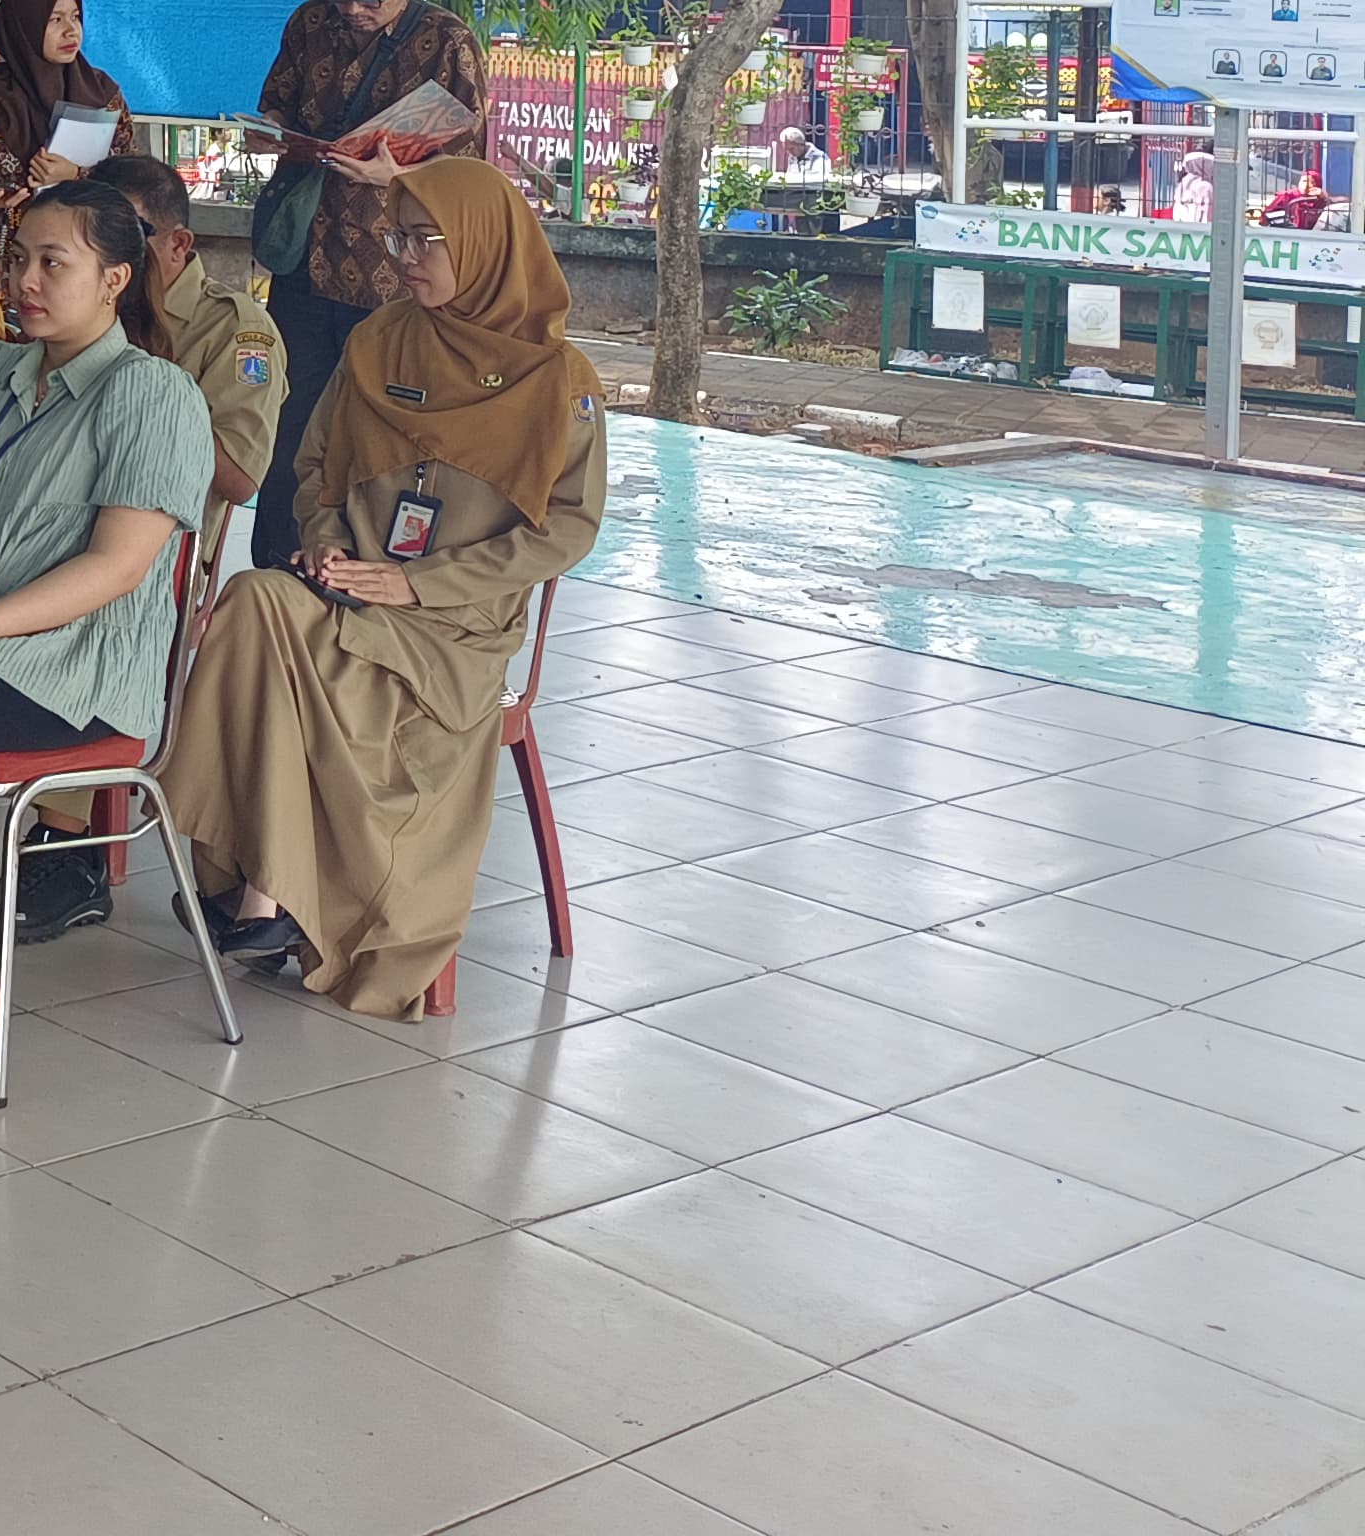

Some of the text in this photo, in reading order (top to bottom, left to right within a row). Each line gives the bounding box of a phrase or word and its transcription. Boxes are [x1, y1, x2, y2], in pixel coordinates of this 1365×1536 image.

[498, 101, 611, 134] TASYAKUAN
[535, 136, 622, 166] PEMDAM
[998, 220, 1301, 271] BANK SAMAH
